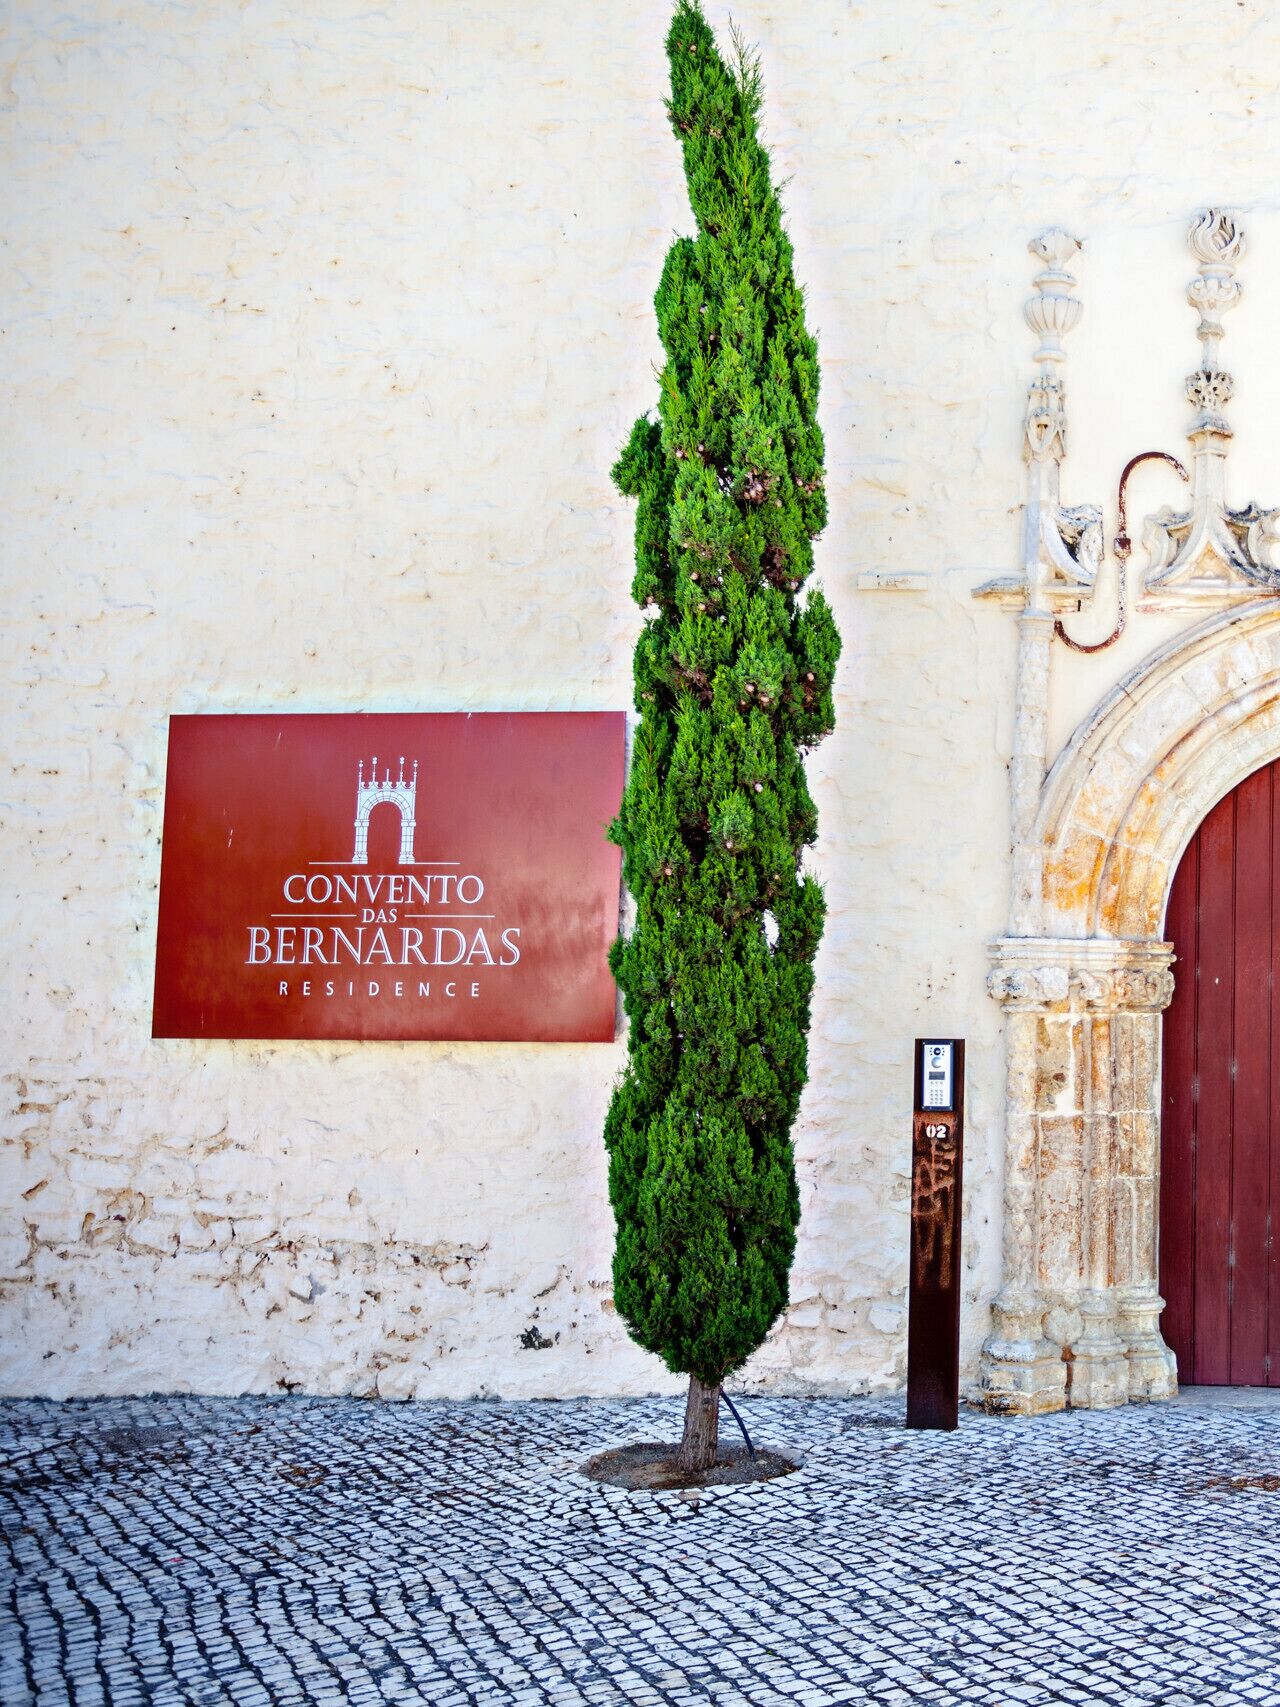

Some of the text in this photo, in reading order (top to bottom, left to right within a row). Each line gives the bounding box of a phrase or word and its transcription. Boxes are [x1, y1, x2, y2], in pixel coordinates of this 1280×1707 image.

[283, 874, 485, 904] CONVENTO
[362, 908, 398, 924] DAS
[245, 927, 521, 966] BERNARDAS
[279, 981, 480, 997] RESIDENCE
[926, 1124, 947, 1138] 02
